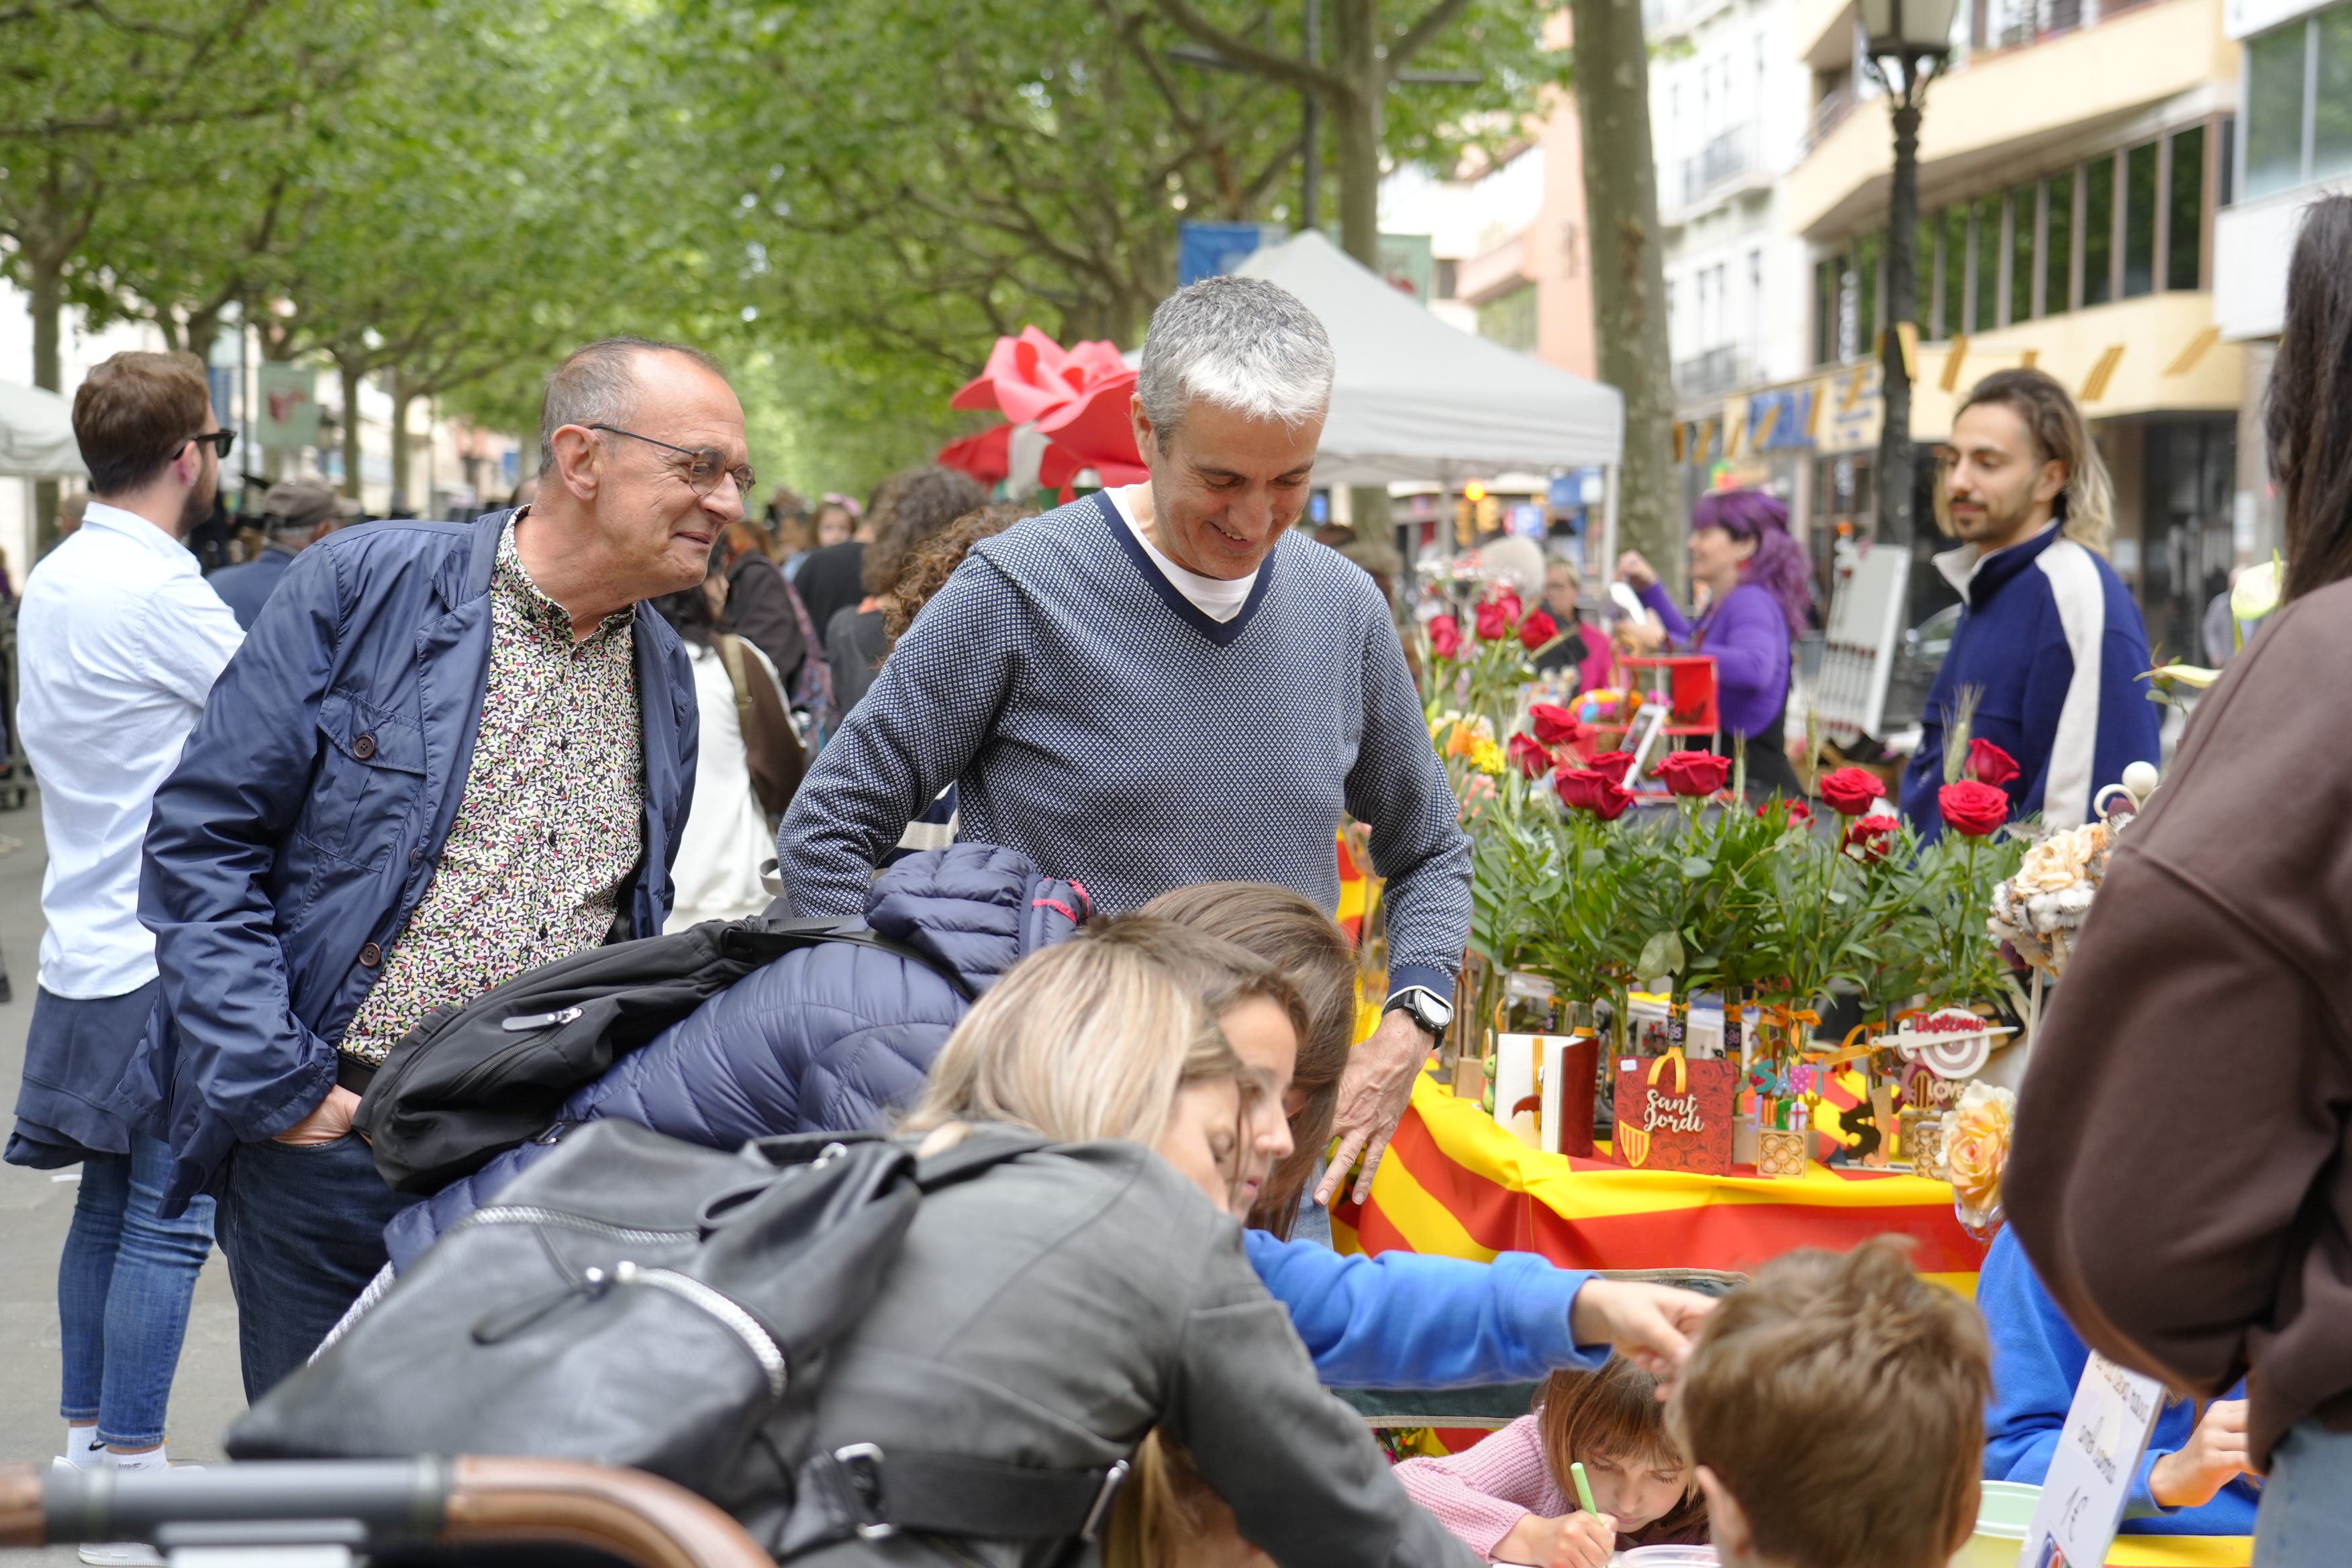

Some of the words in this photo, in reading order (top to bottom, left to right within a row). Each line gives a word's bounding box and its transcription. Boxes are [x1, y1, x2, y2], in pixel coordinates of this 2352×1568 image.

[1646, 1088, 1698, 1116] Sant
[1927, 1079, 1965, 1099] LOVE
[1644, 1106, 1705, 1133] Jordi
